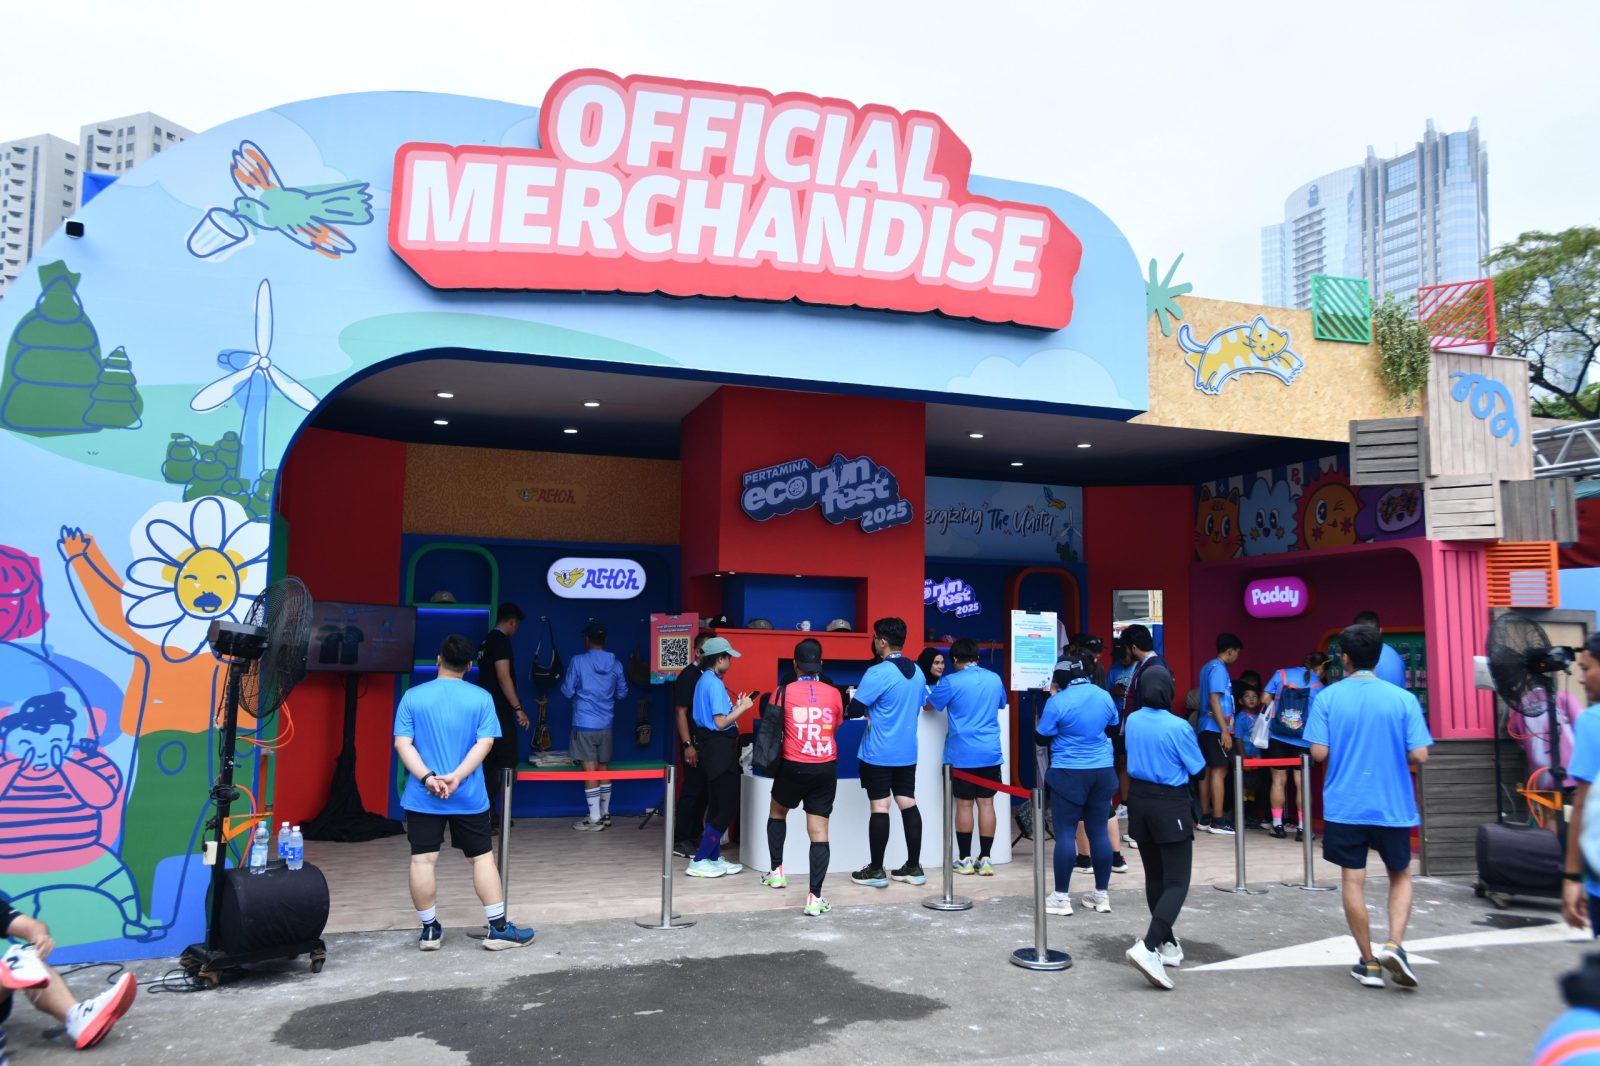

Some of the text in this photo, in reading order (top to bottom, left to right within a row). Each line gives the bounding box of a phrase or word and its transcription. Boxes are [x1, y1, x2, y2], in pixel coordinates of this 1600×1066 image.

[556, 84, 943, 199] OFFICIAL
[406, 159, 1045, 289] MERCHANDISE
[744, 460, 809, 485] PERTAMINA
[822, 473, 890, 514] fest
[862, 501, 908, 527] 2025
[987, 508, 1010, 531] The
[1012, 509, 1055, 537] Unity
[937, 587, 971, 608] fest
[956, 602, 979, 615] 2025
[1251, 585, 1300, 608] Paddy
